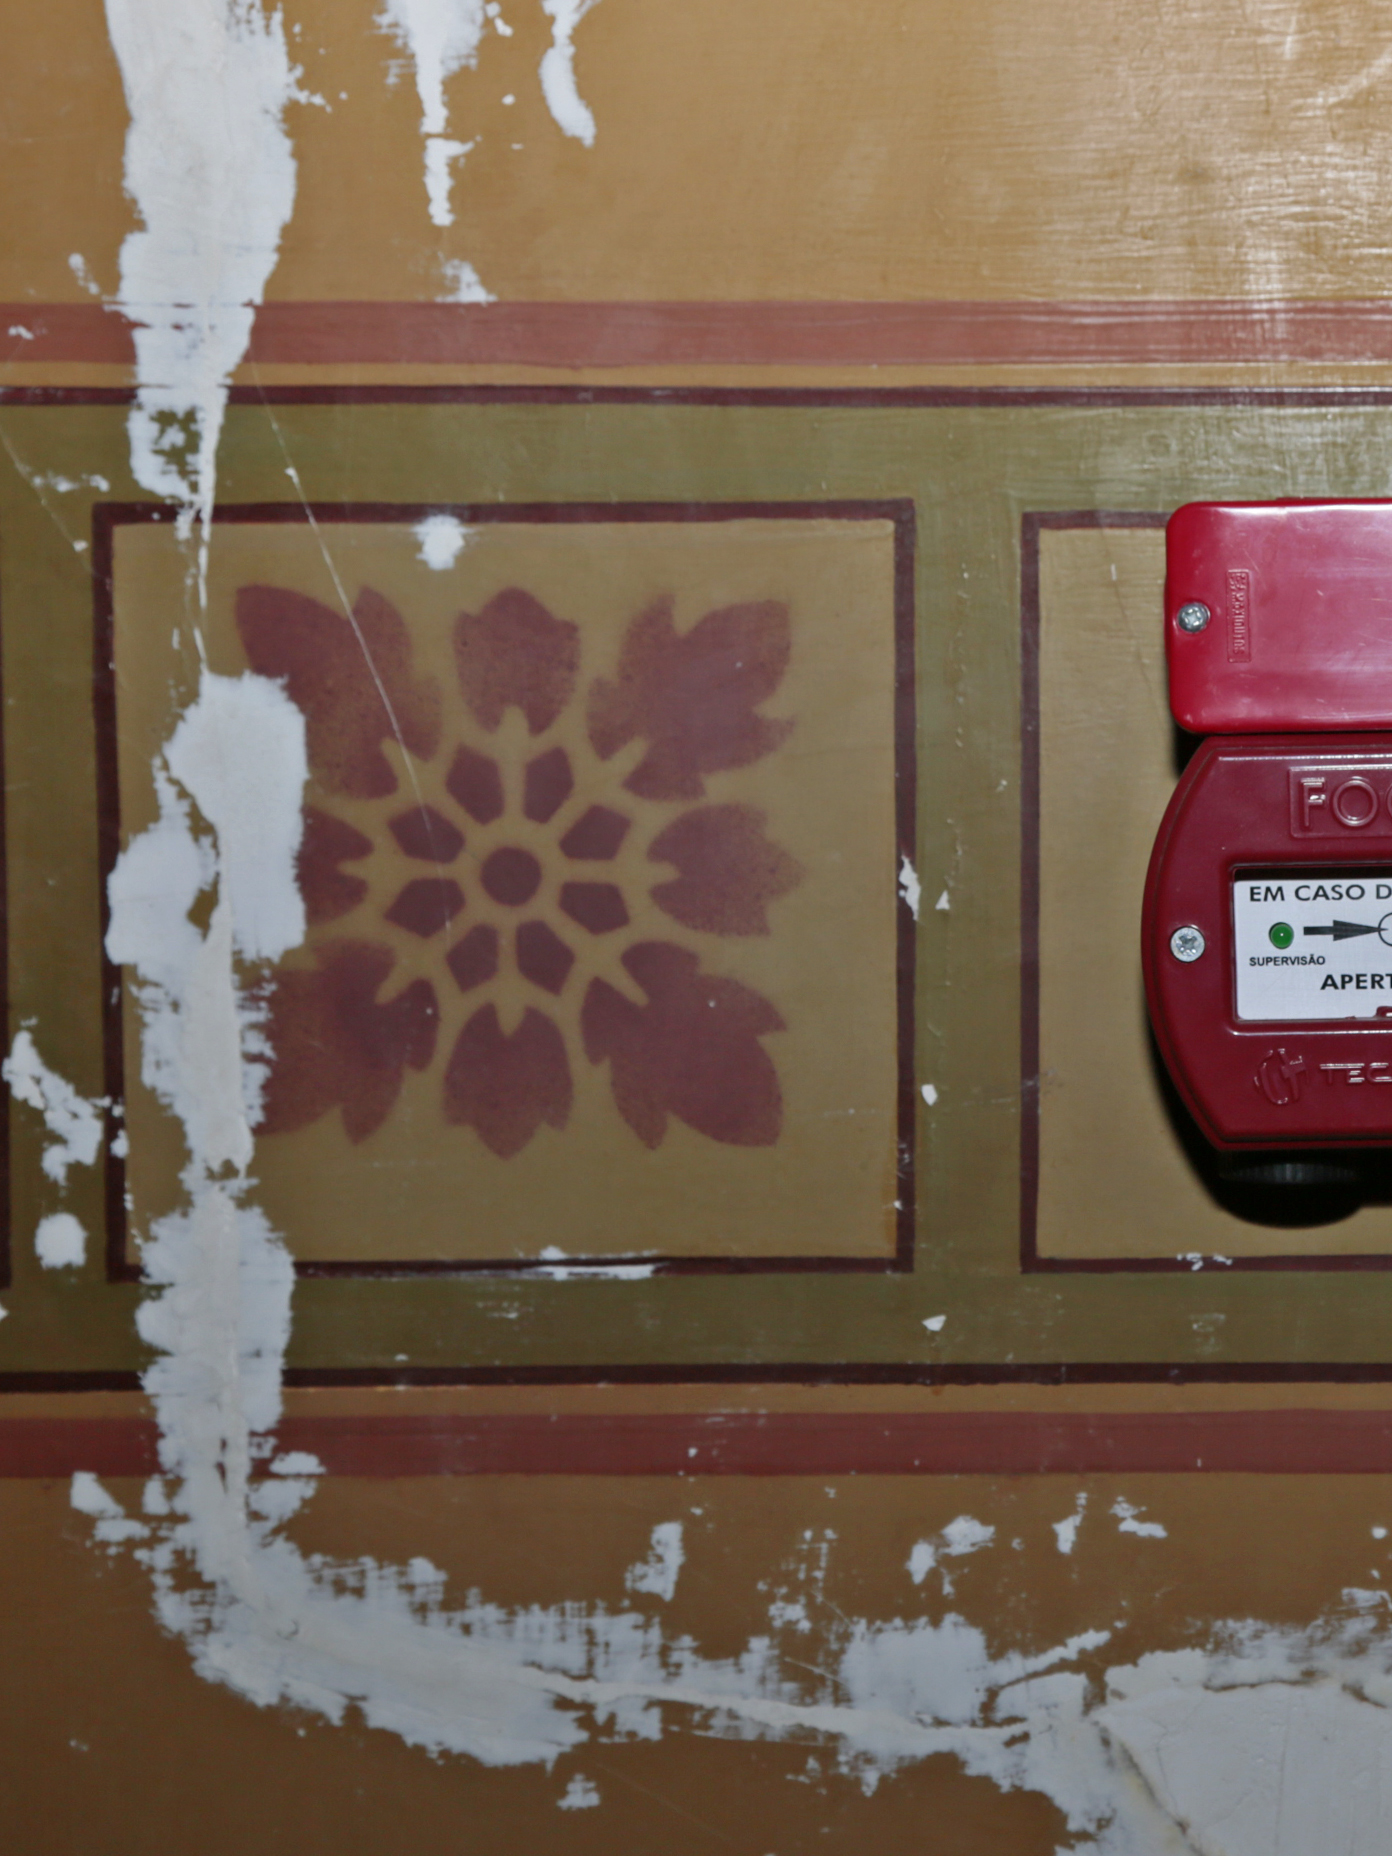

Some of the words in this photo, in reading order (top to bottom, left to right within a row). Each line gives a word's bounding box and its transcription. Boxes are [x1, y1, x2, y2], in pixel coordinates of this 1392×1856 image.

[1250, 886, 1284, 901] EM
[1295, 885, 1365, 901] CASO
[1250, 954, 1325, 966] SUPERVISÃO
